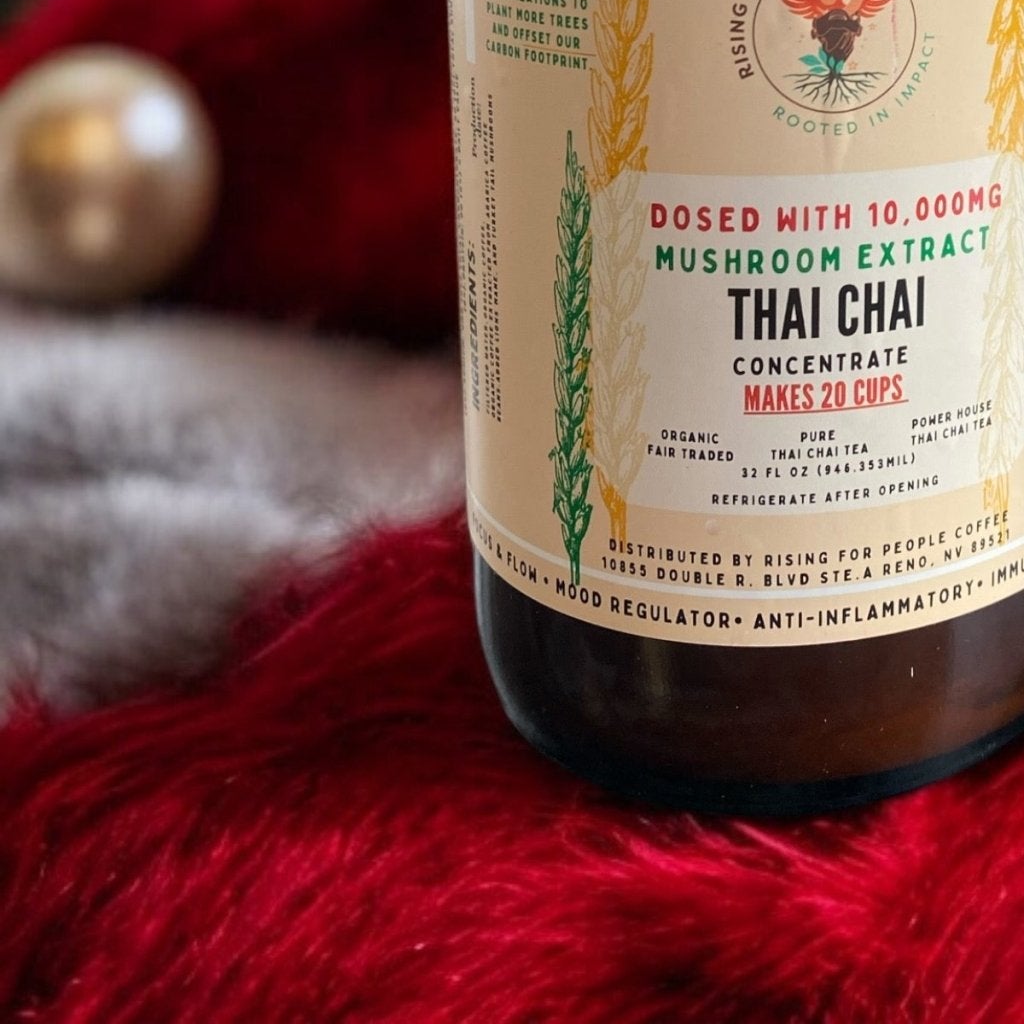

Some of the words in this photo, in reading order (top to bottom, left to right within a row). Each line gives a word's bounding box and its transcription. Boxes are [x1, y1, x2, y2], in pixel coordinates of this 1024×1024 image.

[486, 2, 512, 19] PLANT
[516, 7, 545, 25] MORE
[550, 13, 589, 30] TREES
[486, 39, 520, 59] CARBON
[493, 23, 509, 38] AND
[513, 27, 550, 45] OFFSET
[556, 34, 580, 49] OUR
[729, 1, 755, 80] RISING
[772, 105, 858, 136] ROOTED
[869, 109, 889, 127] IN
[895, 32, 936, 107] IMPACT
[651, 202, 760, 233] DOSED
[777, 203, 851, 233] WITH
[868, 182, 1002, 227] 10,000MG
[656, 244, 840, 275] MUSHROOM
[858, 225, 990, 270] EXTRACT
[728, 286, 820, 340] THAI
[838, 275, 925, 338] CHAI
[467, 240, 480, 411] INGREDIENTS:
[733, 345, 908, 376] CONCENTRATE
[743, 383, 814, 413] MAKES
[821, 380, 846, 409] 20
[853, 374, 903, 405] CUPS
[911, 433, 938, 446] THAI
[942, 424, 969, 439] CHAI
[973, 415, 992, 432] TEA
[912, 411, 952, 430] POWER
[957, 400, 992, 420] HOUSE
[661, 429, 719, 444] ORGANIC
[771, 449, 802, 460] THAI
[807, 445, 839, 459] CHAI
[844, 443, 869, 455] TEA
[800, 430, 836, 443] PURE
[648, 444, 676, 459] FAIR
[681, 448, 734, 462] TRADED
[741, 467, 758, 478] 32
[765, 466, 781, 478] FL
[790, 466, 808, 477] OZ
[817, 452, 916, 477] (946.353MIL)
[712, 493, 816, 505] REFRIGERATE
[825, 488, 870, 503] AFTER
[879, 475, 939, 496] OPENING
[609, 538, 722, 566] DISTRIBUTED
[732, 554, 752, 567] BY
[764, 551, 828, 568] RISING
[839, 547, 872, 562] FOR
[883, 531, 946, 557] PEOPLE
[955, 510, 1009, 539] COFFEE
[602, 556, 647, 577] 10855
[657, 567, 725, 587] DOUBLE
[764, 573, 808, 587] BLVD
[944, 546, 962, 561] NV
[971, 528, 1010, 553] 89521
[496, 544, 502, 559] &
[507, 552, 537, 584] FLOW
[556, 578, 601, 608] MOOD
[611, 596, 730, 628] REGULATOR
[753, 581, 973, 630] ANTI-INFLAMMATORY
